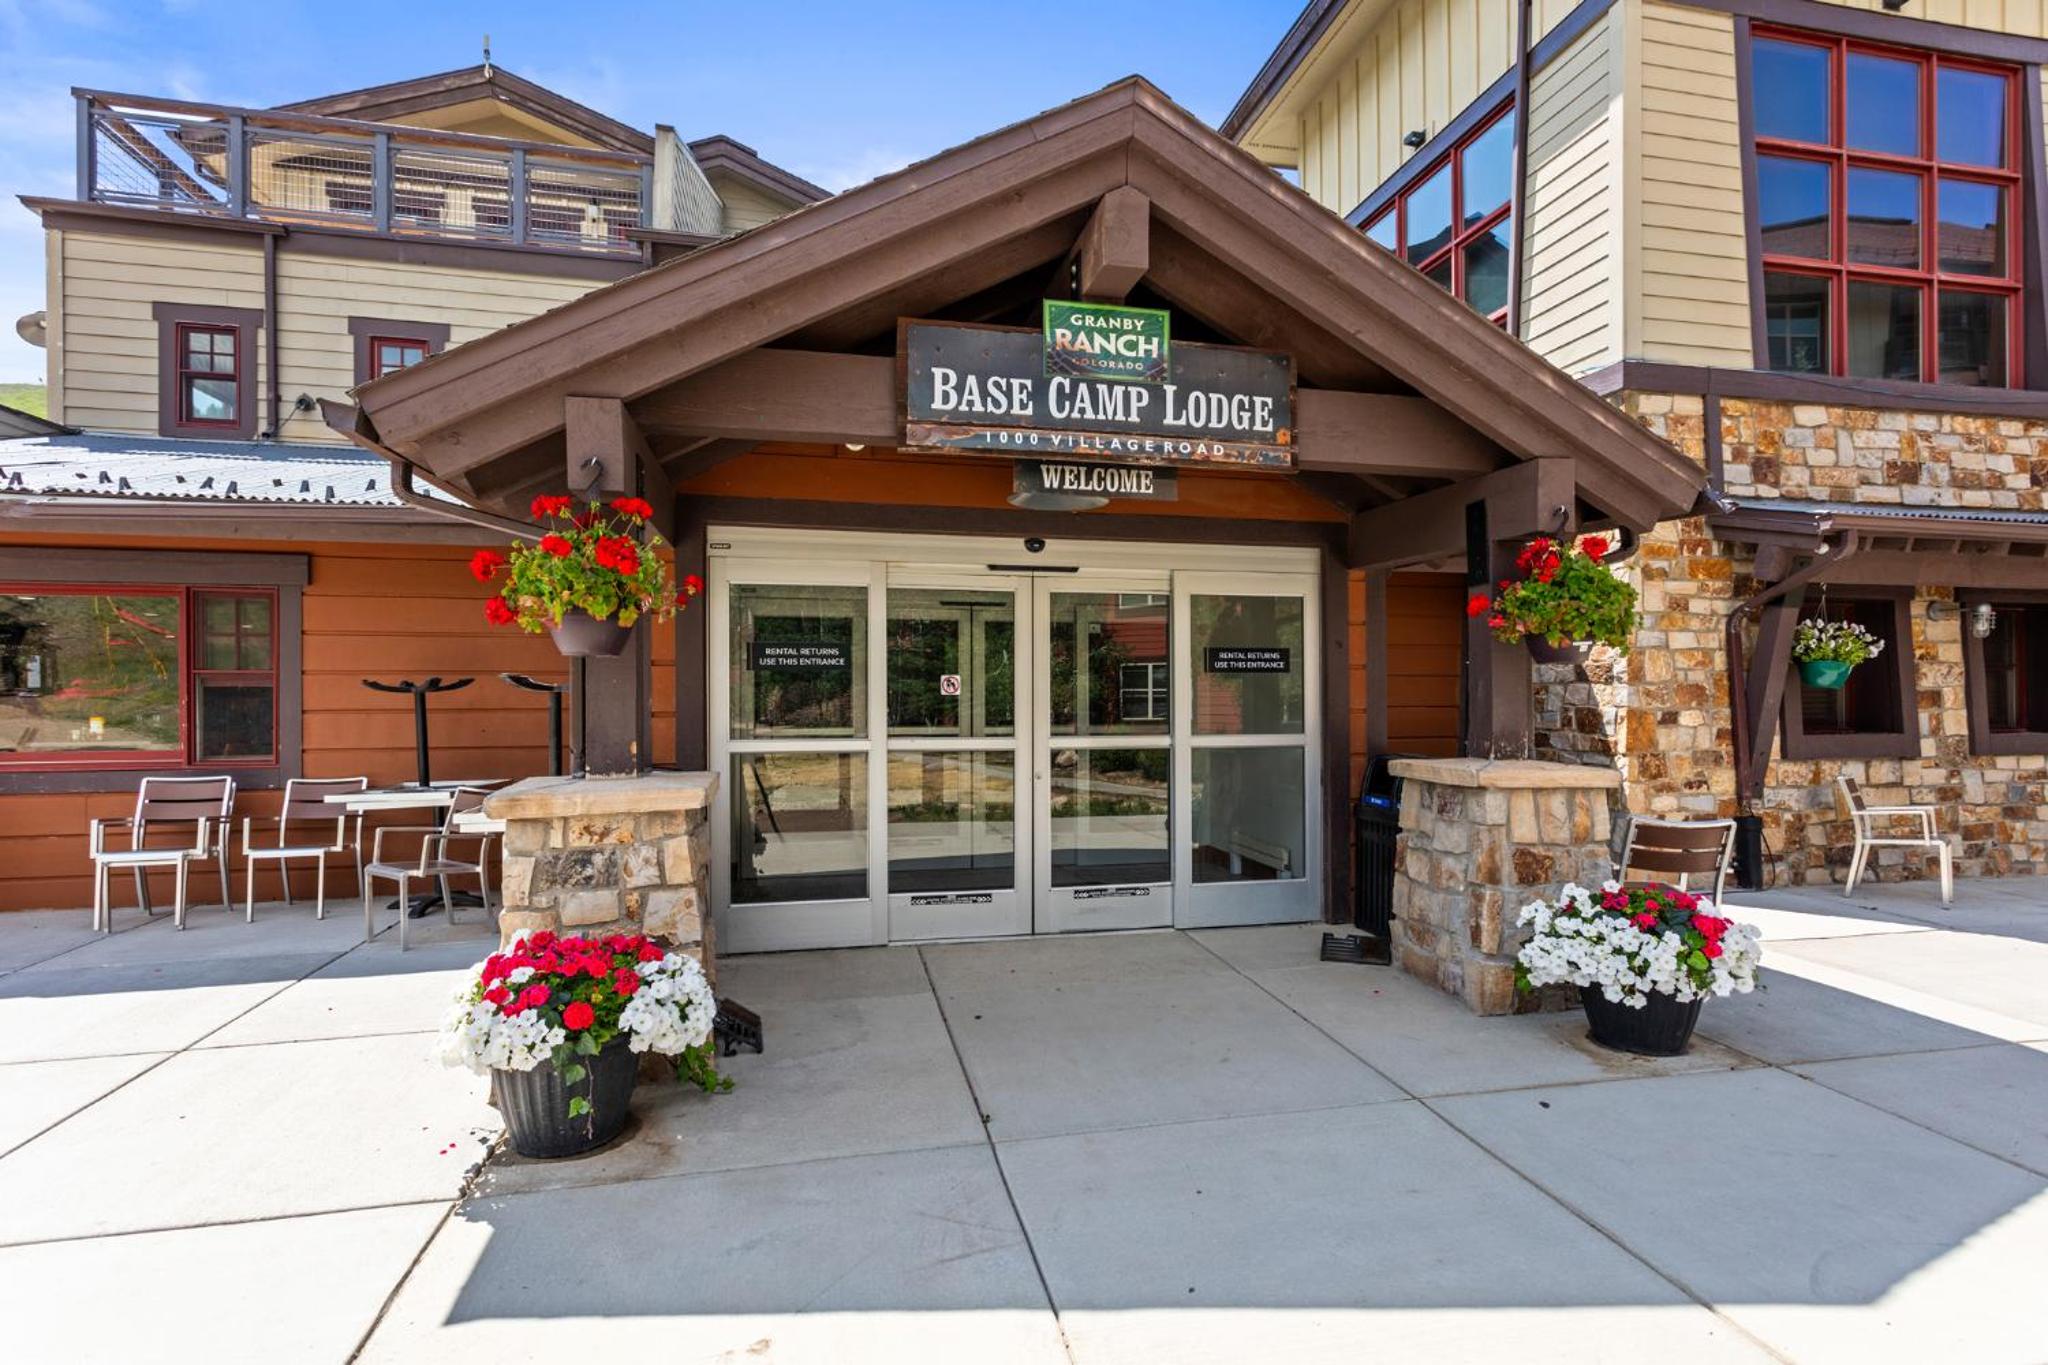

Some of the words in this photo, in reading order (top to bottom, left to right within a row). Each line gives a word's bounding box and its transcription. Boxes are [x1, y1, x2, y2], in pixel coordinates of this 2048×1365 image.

[1070, 314, 1145, 331] GRANBY
[1055, 328, 1160, 358] RANCH
[930, 366, 1033, 416] BASE
[1048, 376, 1150, 423] CAMP
[1163, 384, 1274, 432] LODGE
[985, 431, 1039, 445] 1000
[1051, 434, 1154, 451] VILLAGE
[1163, 441, 1225, 456] ROAD
[1040, 463, 1154, 494] WELCOME
[765, 647, 798, 655] RENTAL
[800, 647, 839, 655] RETURNS
[1218, 651, 1246, 659] RENTAL
[1247, 651, 1280, 659] RETURNS
[759, 657, 777, 666] USE
[778, 657, 798, 666] THIS
[799, 657, 845, 666] ENTRANCE
[1214, 661, 1228, 669] USE
[1229, 661, 1246, 669] THIS
[1247, 661, 1284, 669] ENTRANCE
